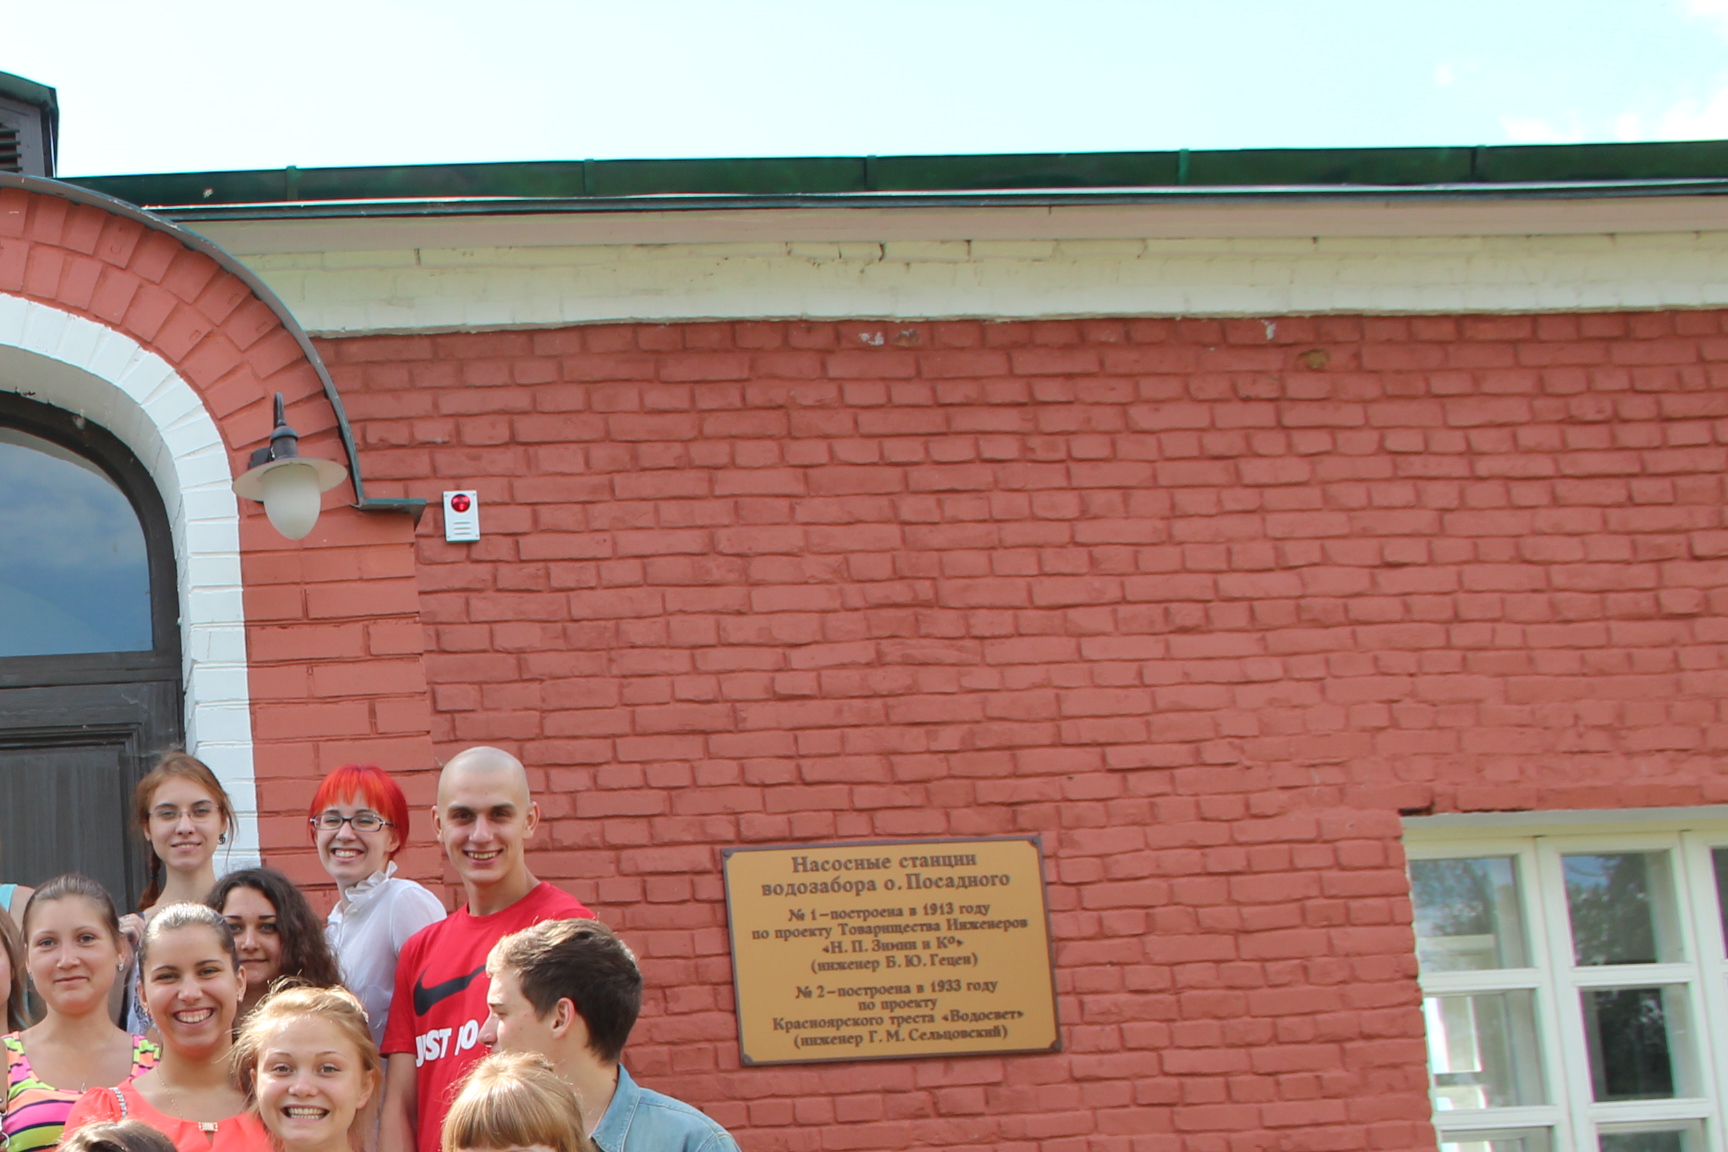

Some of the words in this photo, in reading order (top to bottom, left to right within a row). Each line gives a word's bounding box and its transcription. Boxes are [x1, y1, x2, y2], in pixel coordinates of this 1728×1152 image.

[791, 856, 892, 873] Насосные
[899, 854, 977, 868] станции
[761, 875, 877, 897] водозабора
[905, 873, 1011, 890] Посадного
[788, 908, 805, 922] №
[908, 906, 917, 917] в
[923, 901, 954, 916] 1913
[958, 903, 991, 917] году
[752, 929, 769, 940] по
[774, 927, 833, 942] проекту
[837, 921, 942, 938] Товарищества
[946, 918, 1029, 932] Инженеров
[921, 940, 931, 950] и
[810, 958, 880, 975] (инженер
[795, 985, 813, 999] №
[916, 984, 925, 994] в
[930, 979, 962, 992] 1933
[966, 980, 998, 994] году
[858, 1000, 876, 1011] по
[880, 998, 938, 1013] проекту
[772, 1015, 885, 1034] Красноярского
[889, 1014, 935, 1028] треста
[941, 1009, 1024, 1023] «Водосвет»
[793, 1033, 863, 1050] (инженер
[908, 1024, 1008, 1041] Сельцовский)
